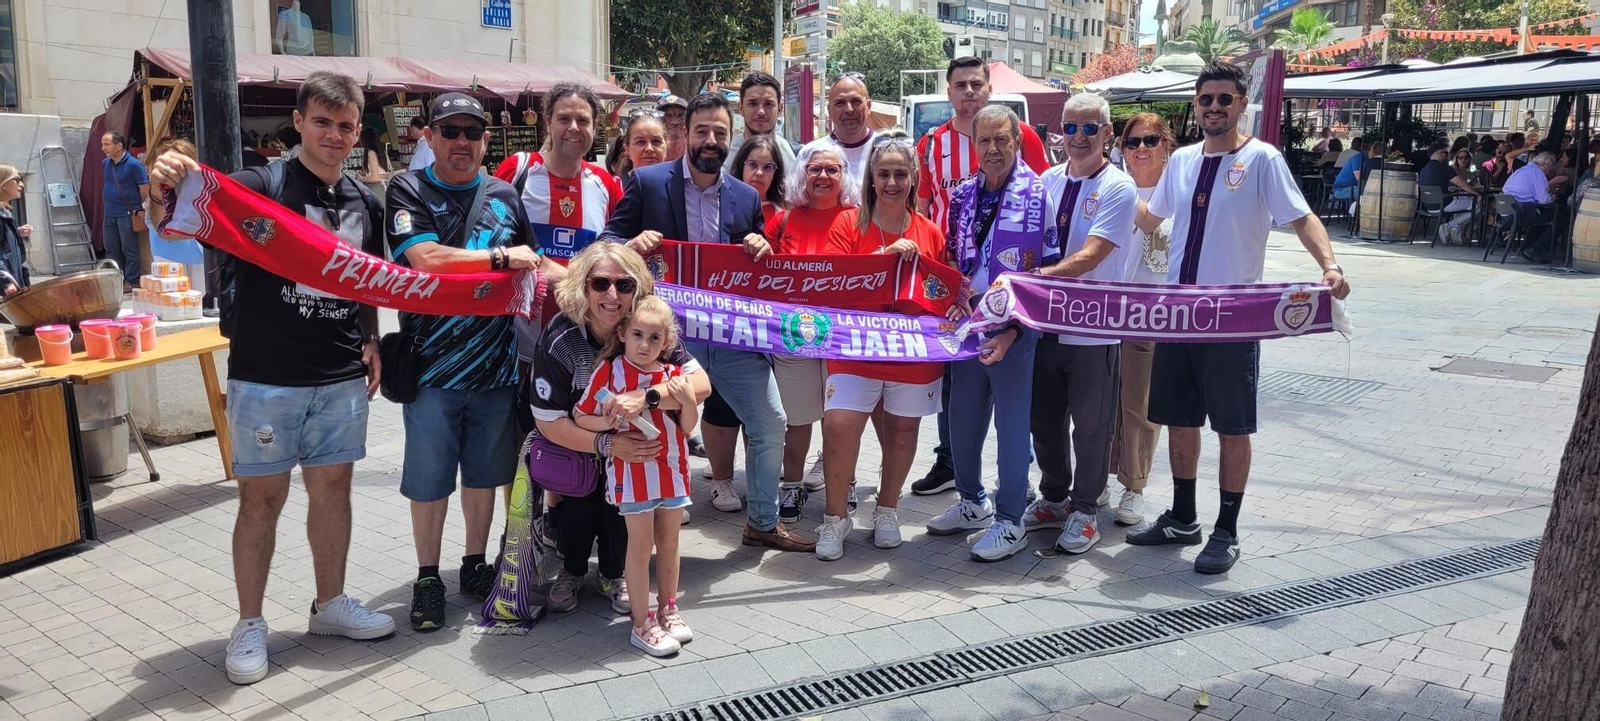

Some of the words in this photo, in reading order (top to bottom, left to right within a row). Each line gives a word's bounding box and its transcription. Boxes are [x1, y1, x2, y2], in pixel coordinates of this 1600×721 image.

[321, 248, 440, 300] PRIMERA
[765, 259, 781, 269] UD
[782, 259, 834, 272] ALMERÍA
[708, 270, 752, 289] HIJOS
[757, 274, 796, 294] DEL
[801, 270, 888, 293] DESIERTO
[299, 305, 314, 319] MY
[317, 308, 349, 320] SENSES
[716, 296, 733, 311] DE
[735, 299, 773, 317] PEÑAS
[685, 308, 774, 350] REAL
[837, 314, 855, 326] LA
[857, 315, 922, 331] VICTORIA
[841, 329, 928, 358] JAÉN
